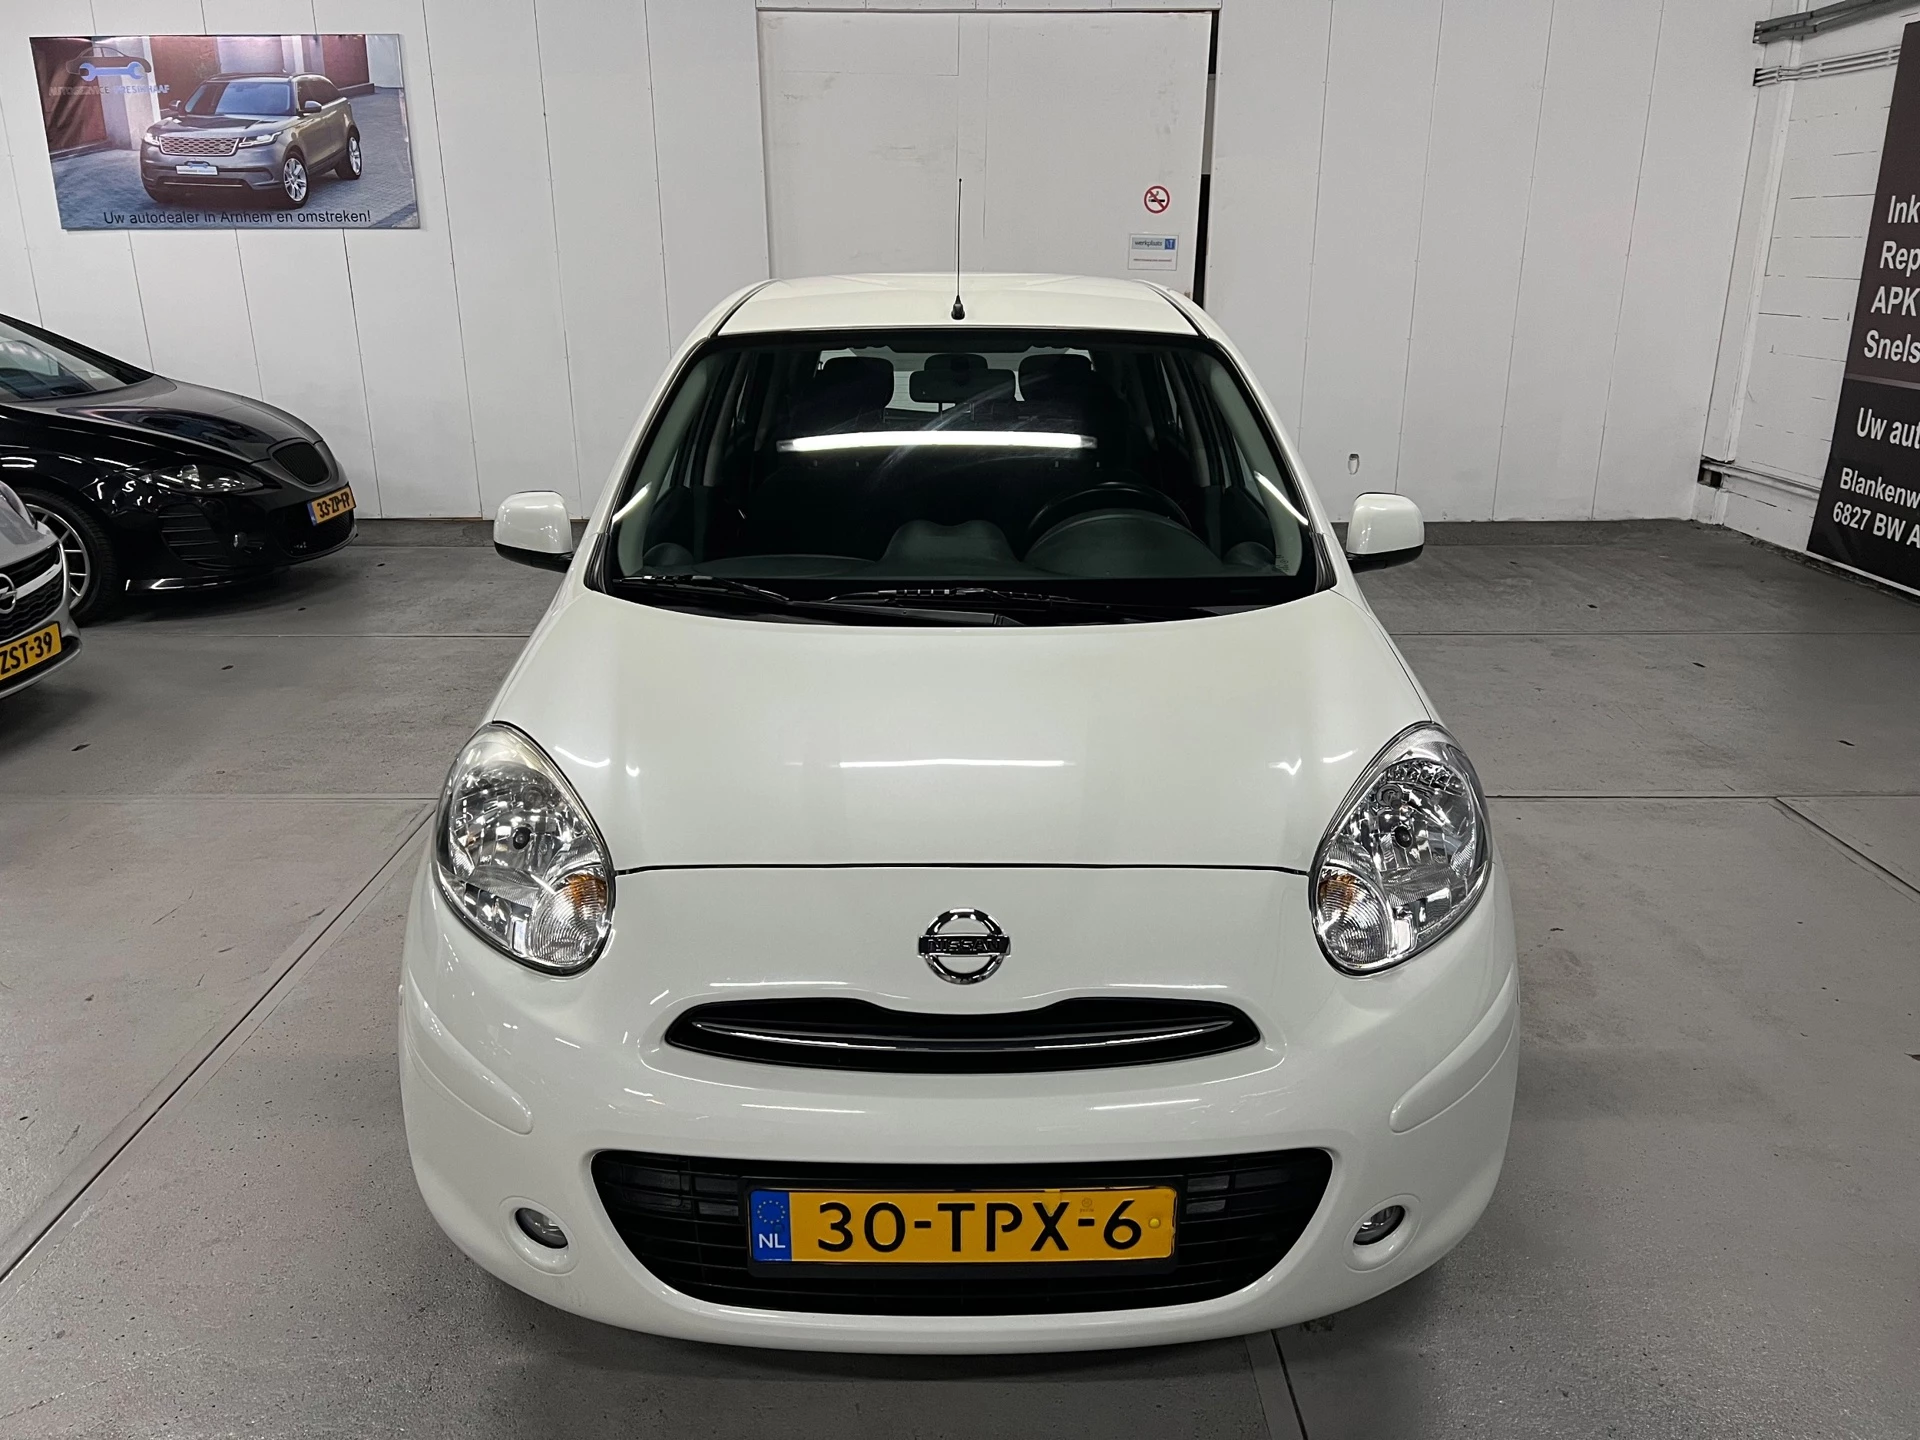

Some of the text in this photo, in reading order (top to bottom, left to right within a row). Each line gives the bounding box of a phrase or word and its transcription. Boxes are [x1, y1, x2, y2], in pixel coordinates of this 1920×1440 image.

[103, 210, 371, 224] Uw autodealer in Arnhem en omstreken!
[1887, 194, 1920, 224] Ink
[1879, 240, 1920, 277] Rep
[1870, 285, 1920, 317] APK
[1863, 329, 1920, 364] Snels
[1856, 407, 1888, 441] Uw
[1839, 467, 1920, 509] Blankenw
[1832, 501, 1871, 531] 6827
[1872, 512, 1907, 542] BW
[0, 631, 52, 675] ZST-39
[927, 938, 1001, 952] NISSAN
[758, 1233, 786, 1249] NL
[816, 1199, 1142, 1252] 30-TPX-6
